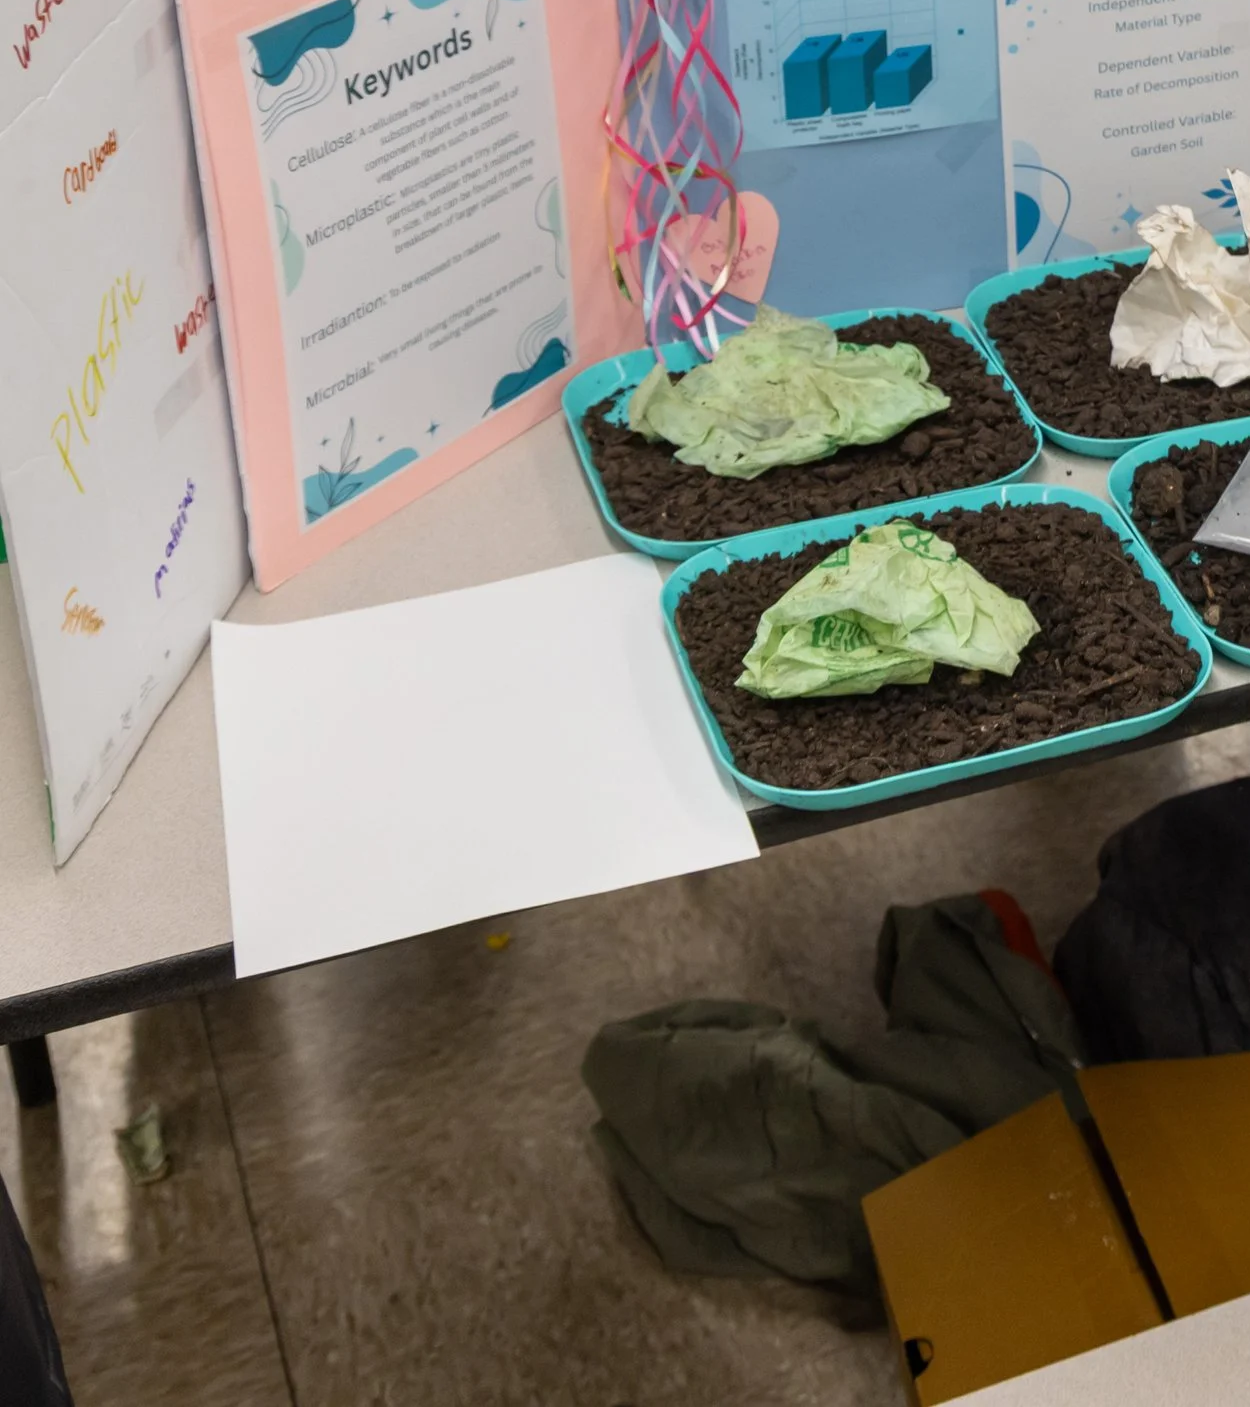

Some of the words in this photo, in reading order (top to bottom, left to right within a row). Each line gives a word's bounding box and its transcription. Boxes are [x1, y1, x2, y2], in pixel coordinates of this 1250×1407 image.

[1115, 15, 1168, 32] Material
[1172, 12, 1202, 26] Type
[344, 27, 472, 105] Keywords
[1098, 54, 1174, 74] Dependent
[1094, 88, 1123, 99] Rate
[1127, 83, 1140, 95] of
[1143, 69, 1239, 93] Decomposition
[1102, 118, 1175, 139] Controlled
[1131, 143, 1176, 157] Garden
[1180, 137, 1204, 149] Soil
